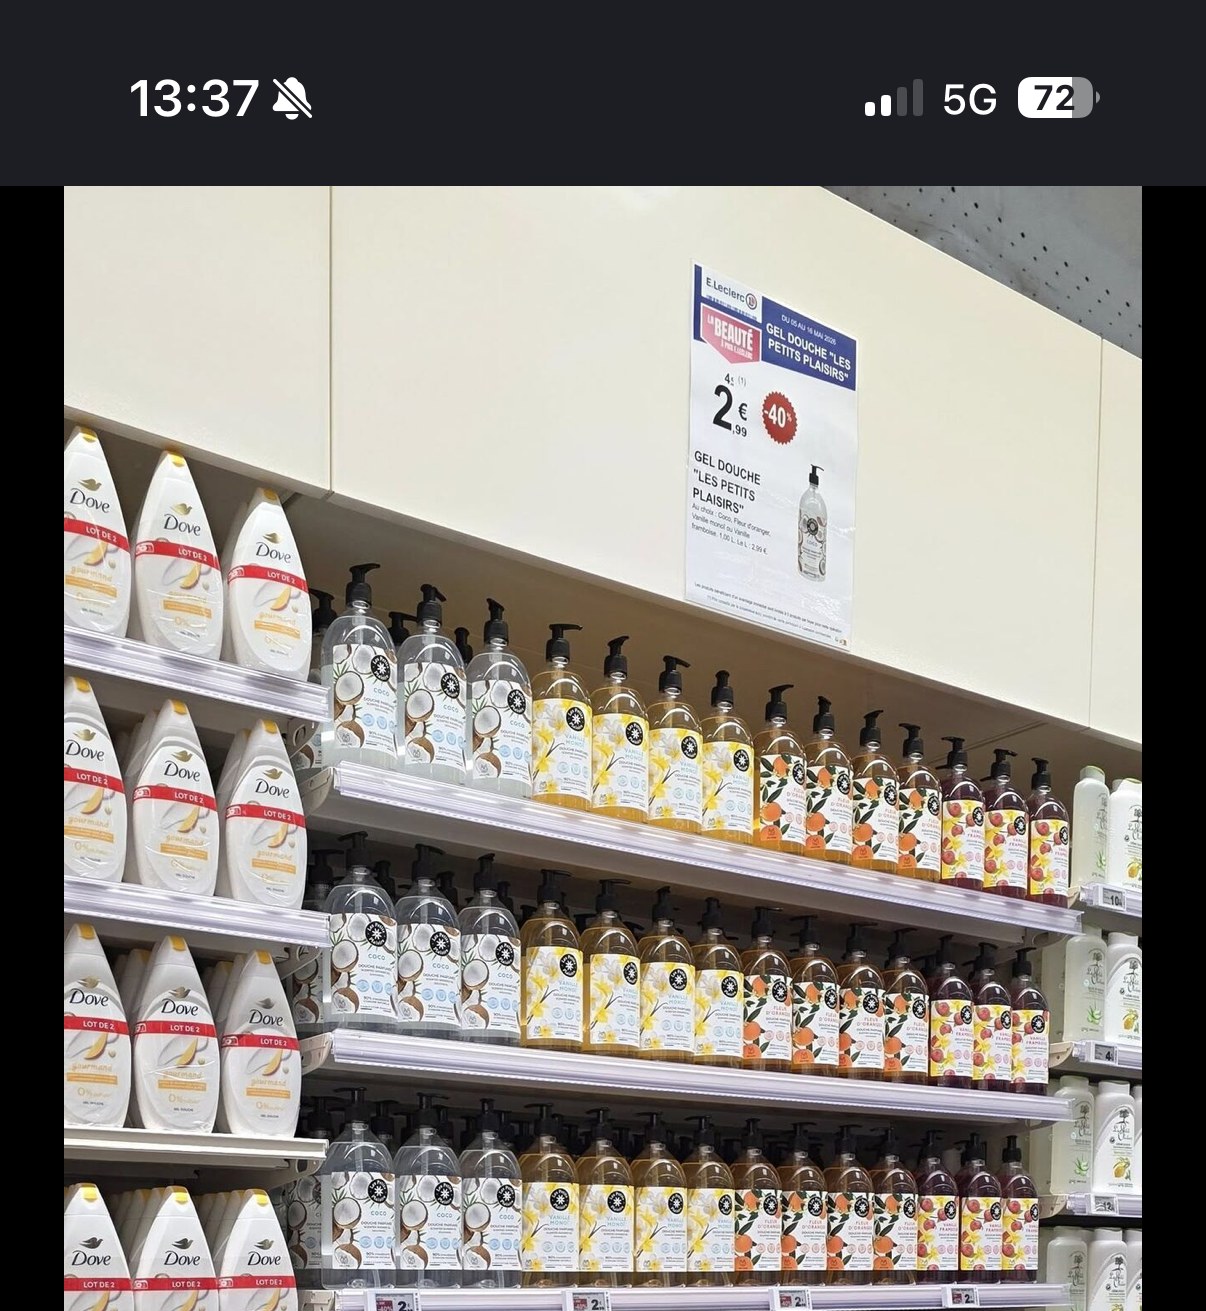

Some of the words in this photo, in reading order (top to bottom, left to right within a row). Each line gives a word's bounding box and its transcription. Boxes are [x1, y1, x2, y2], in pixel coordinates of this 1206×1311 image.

[706, 277, 745, 302] E.Leclerc
[782, 314, 790, 322] DU
[790, 319, 798, 327] 05
[798, 322, 806, 332] AU
[714, 317, 753, 351] BEAUTÉ
[766, 322, 784, 341] GEL
[787, 331, 828, 360] DOUCHE
[768, 338, 801, 362] PETITS
[803, 354, 849, 383] PLAISIRS"
[712, 385, 733, 431] 2
[738, 402, 748, 421] €
[694, 450, 716, 468] GEL
[718, 459, 761, 486] DOUCHE
[693, 469, 718, 488] "LES
[720, 478, 756, 502] PETITS
[70, 488, 110, 514] Dove
[692, 488, 744, 514] PLAISIRS"
[86, 525, 100, 538] LOT
[102, 528, 111, 542] DE
[112, 534, 118, 544] 2
[163, 514, 201, 536] Dove
[178, 548, 193, 558] LOT
[194, 550, 202, 560] DE
[203, 552, 208, 562] 2
[256, 542, 292, 564] Dove
[373, 687, 390, 697] COCO
[443, 704, 459, 713] COCO
[509, 720, 525, 728] COCO
[66, 739, 104, 762] Dove
[76, 772, 91, 782] LOT
[92, 774, 100, 784] DE
[102, 776, 108, 785] 2
[164, 760, 201, 782] Dove
[174, 791, 188, 800] LOT
[189, 793, 198, 802] DE
[198, 795, 204, 804] 2
[255, 778, 290, 798] Dove
[69, 988, 109, 1007] Dove
[160, 998, 198, 1016] Dove
[82, 1020, 96, 1029] LOT
[96, 1021, 107, 1030] DE
[109, 1022, 115, 1031] 2
[249, 1008, 284, 1026] Dove
[170, 1024, 183, 1032] LOT
[184, 1024, 194, 1032] DE
[72, 1250, 111, 1266] Dove
[164, 1250, 201, 1266] Dove
[247, 1250, 281, 1266] Dove
[109, 1280, 115, 1288] 2
